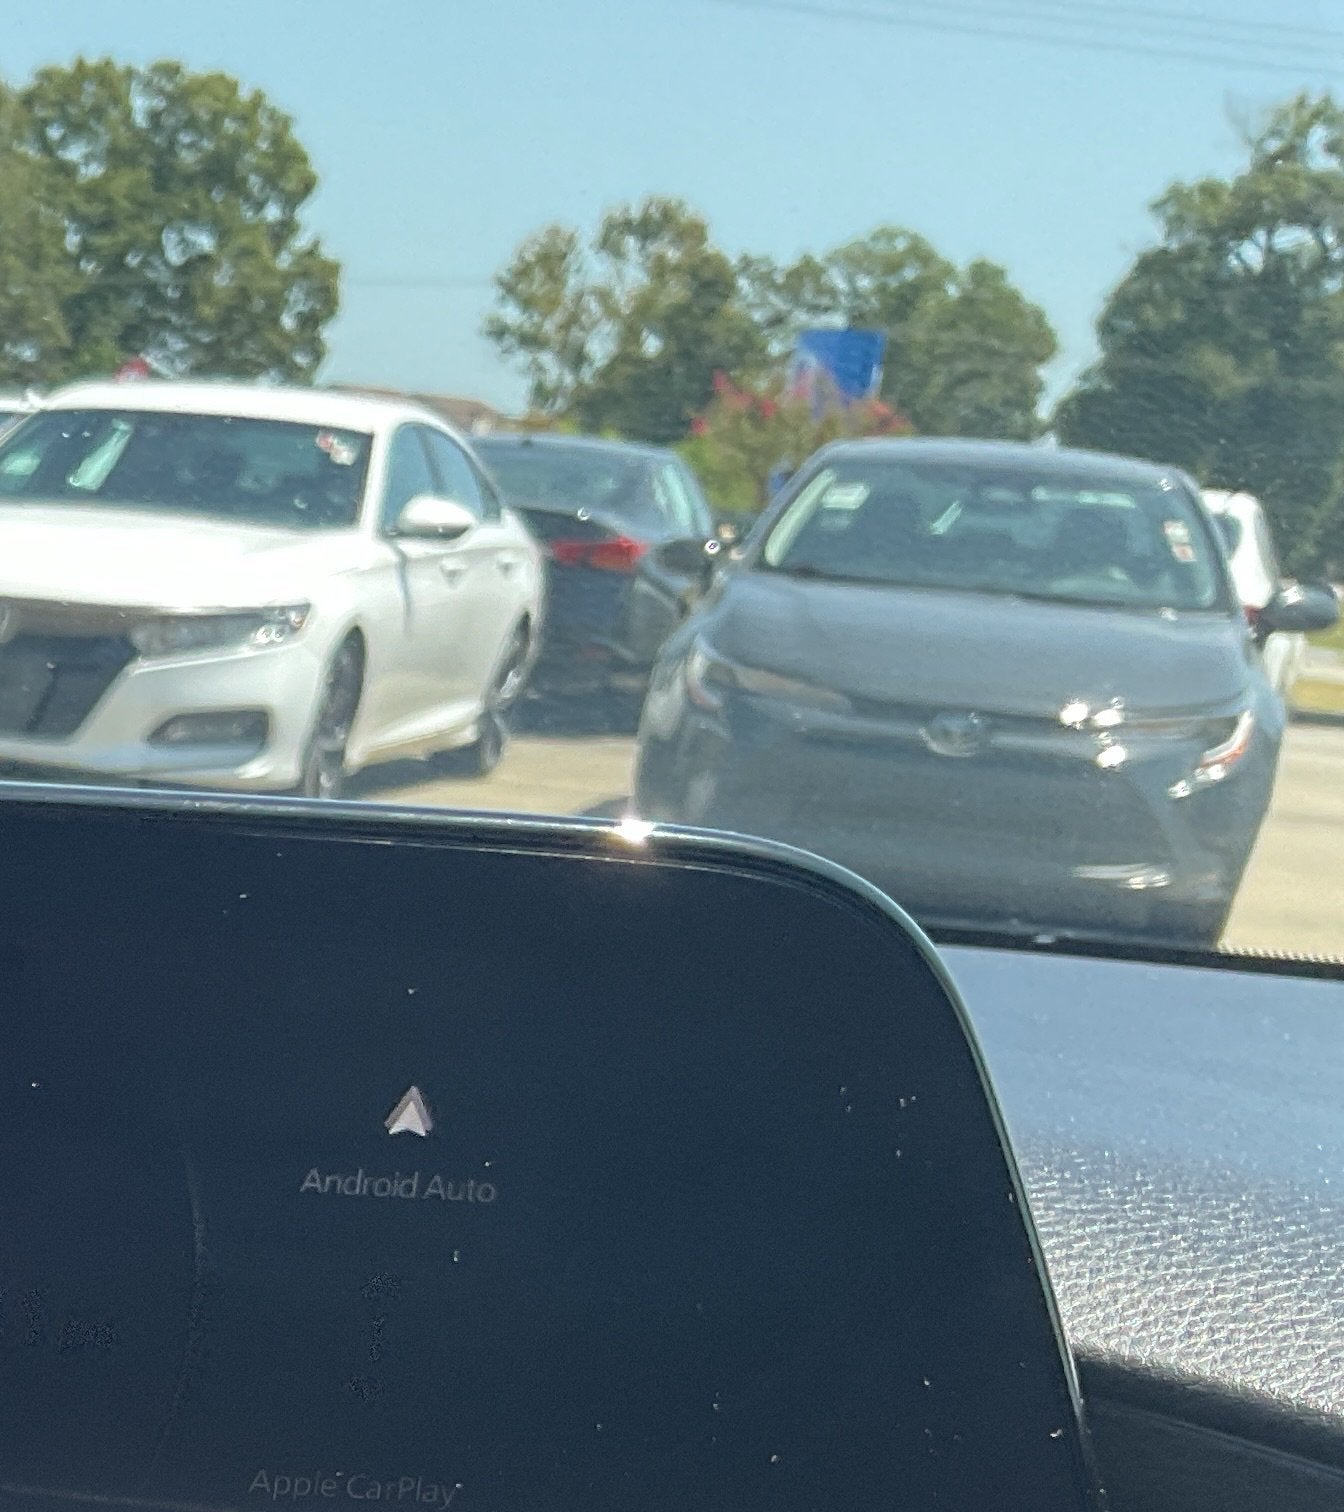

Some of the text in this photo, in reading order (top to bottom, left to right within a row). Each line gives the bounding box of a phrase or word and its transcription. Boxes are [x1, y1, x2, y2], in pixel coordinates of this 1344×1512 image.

[300, 1167, 496, 1203] Android Auto
[248, 1468, 458, 1510] Apple CarPlay
